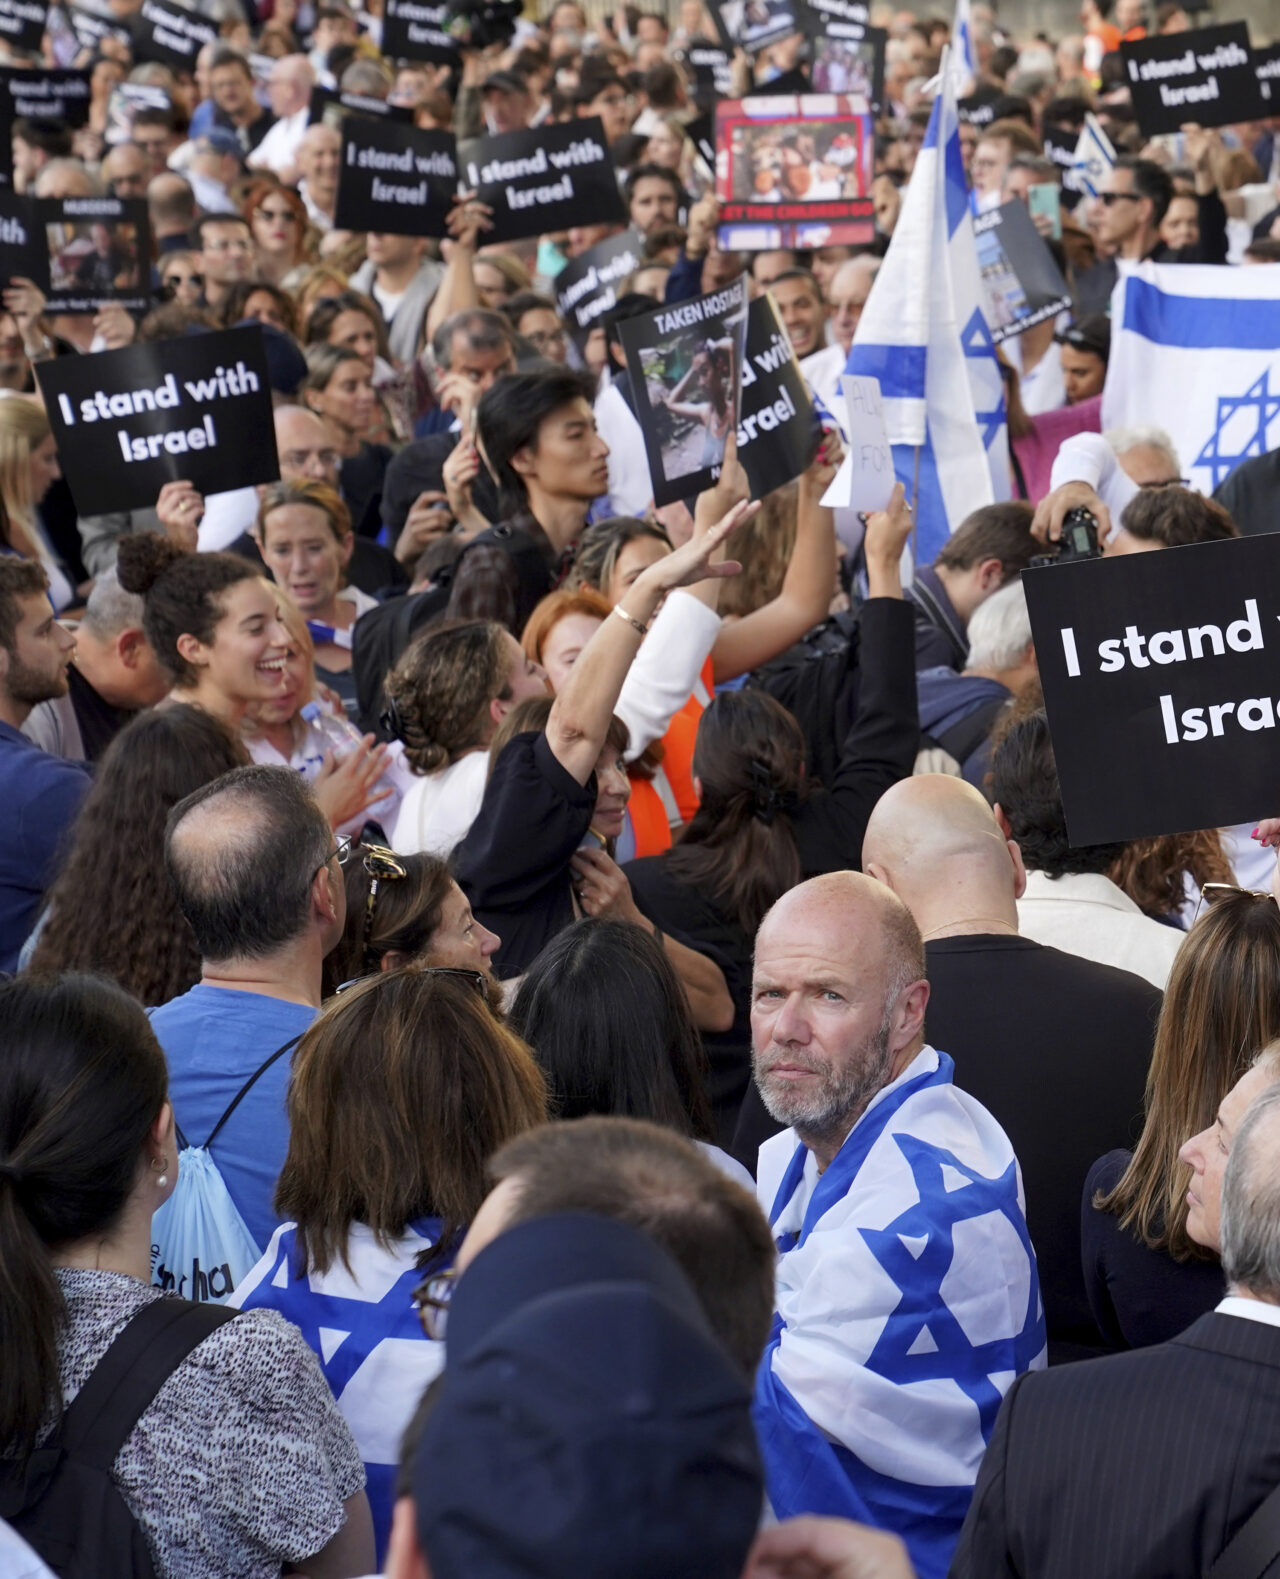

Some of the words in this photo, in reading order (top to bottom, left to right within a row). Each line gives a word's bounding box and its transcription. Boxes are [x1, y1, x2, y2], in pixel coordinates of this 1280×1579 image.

[1128, 59, 1139, 82] I
[1139, 49, 1196, 80] stand
[1197, 41, 1248, 71] with
[1159, 75, 1220, 106] Israel
[347, 141, 355, 166] I
[357, 147, 412, 172] stand
[415, 152, 456, 177] with
[467, 161, 479, 187] I
[481, 147, 548, 185] stand
[549, 138, 604, 169] with
[371, 177, 428, 205] Israel
[505, 174, 574, 210] Israel
[653, 302, 703, 334] TAKEN
[754, 333, 796, 374] wit
[58, 393, 75, 426] I
[80, 373, 181, 423] stand
[184, 361, 260, 402] with
[736, 384, 797, 448] srael
[117, 413, 217, 463] Israel
[1060, 627, 1081, 677] I
[1098, 598, 1265, 673] stand
